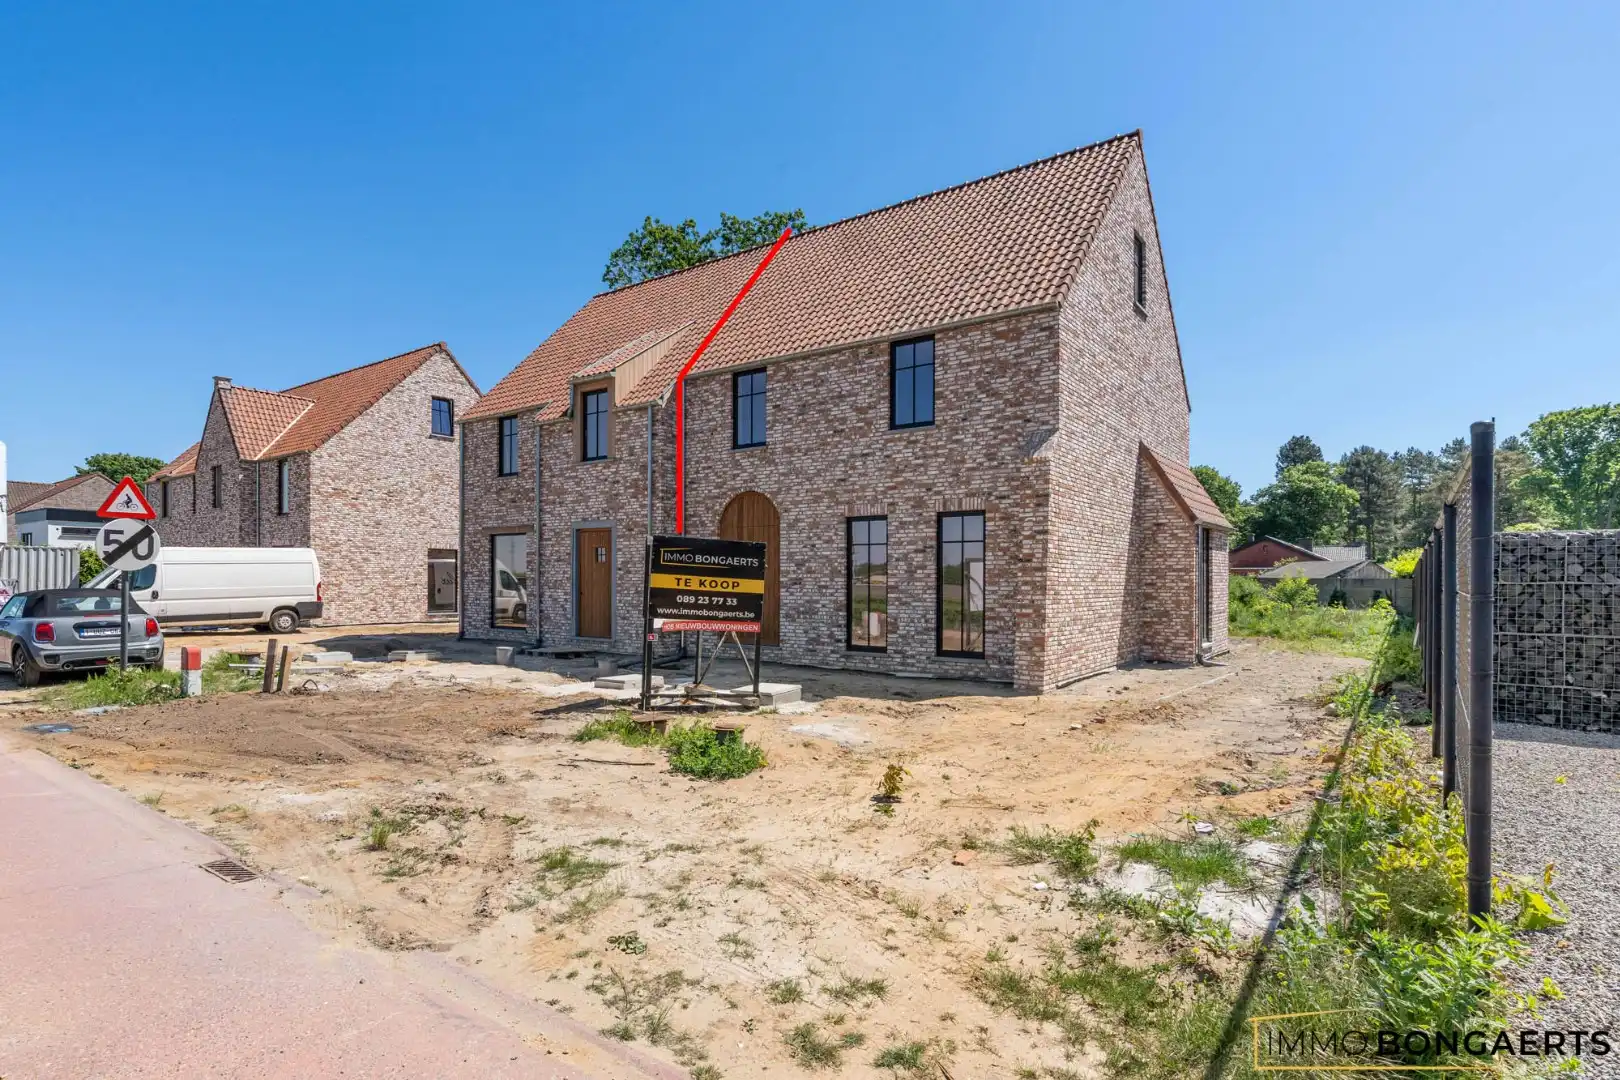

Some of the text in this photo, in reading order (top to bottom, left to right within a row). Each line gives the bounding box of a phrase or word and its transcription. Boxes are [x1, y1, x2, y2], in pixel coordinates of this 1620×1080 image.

[103, 529, 154, 561] 50
[664, 552, 759, 567] IMMO BONGAERTS
[675, 577, 740, 590] TE KOOP
[676, 595, 738, 606] 089 23 77 33
[657, 607, 755, 618] www.immobongaerts.be
[675, 622, 759, 631] NIEUWBOUWWONINGEN
